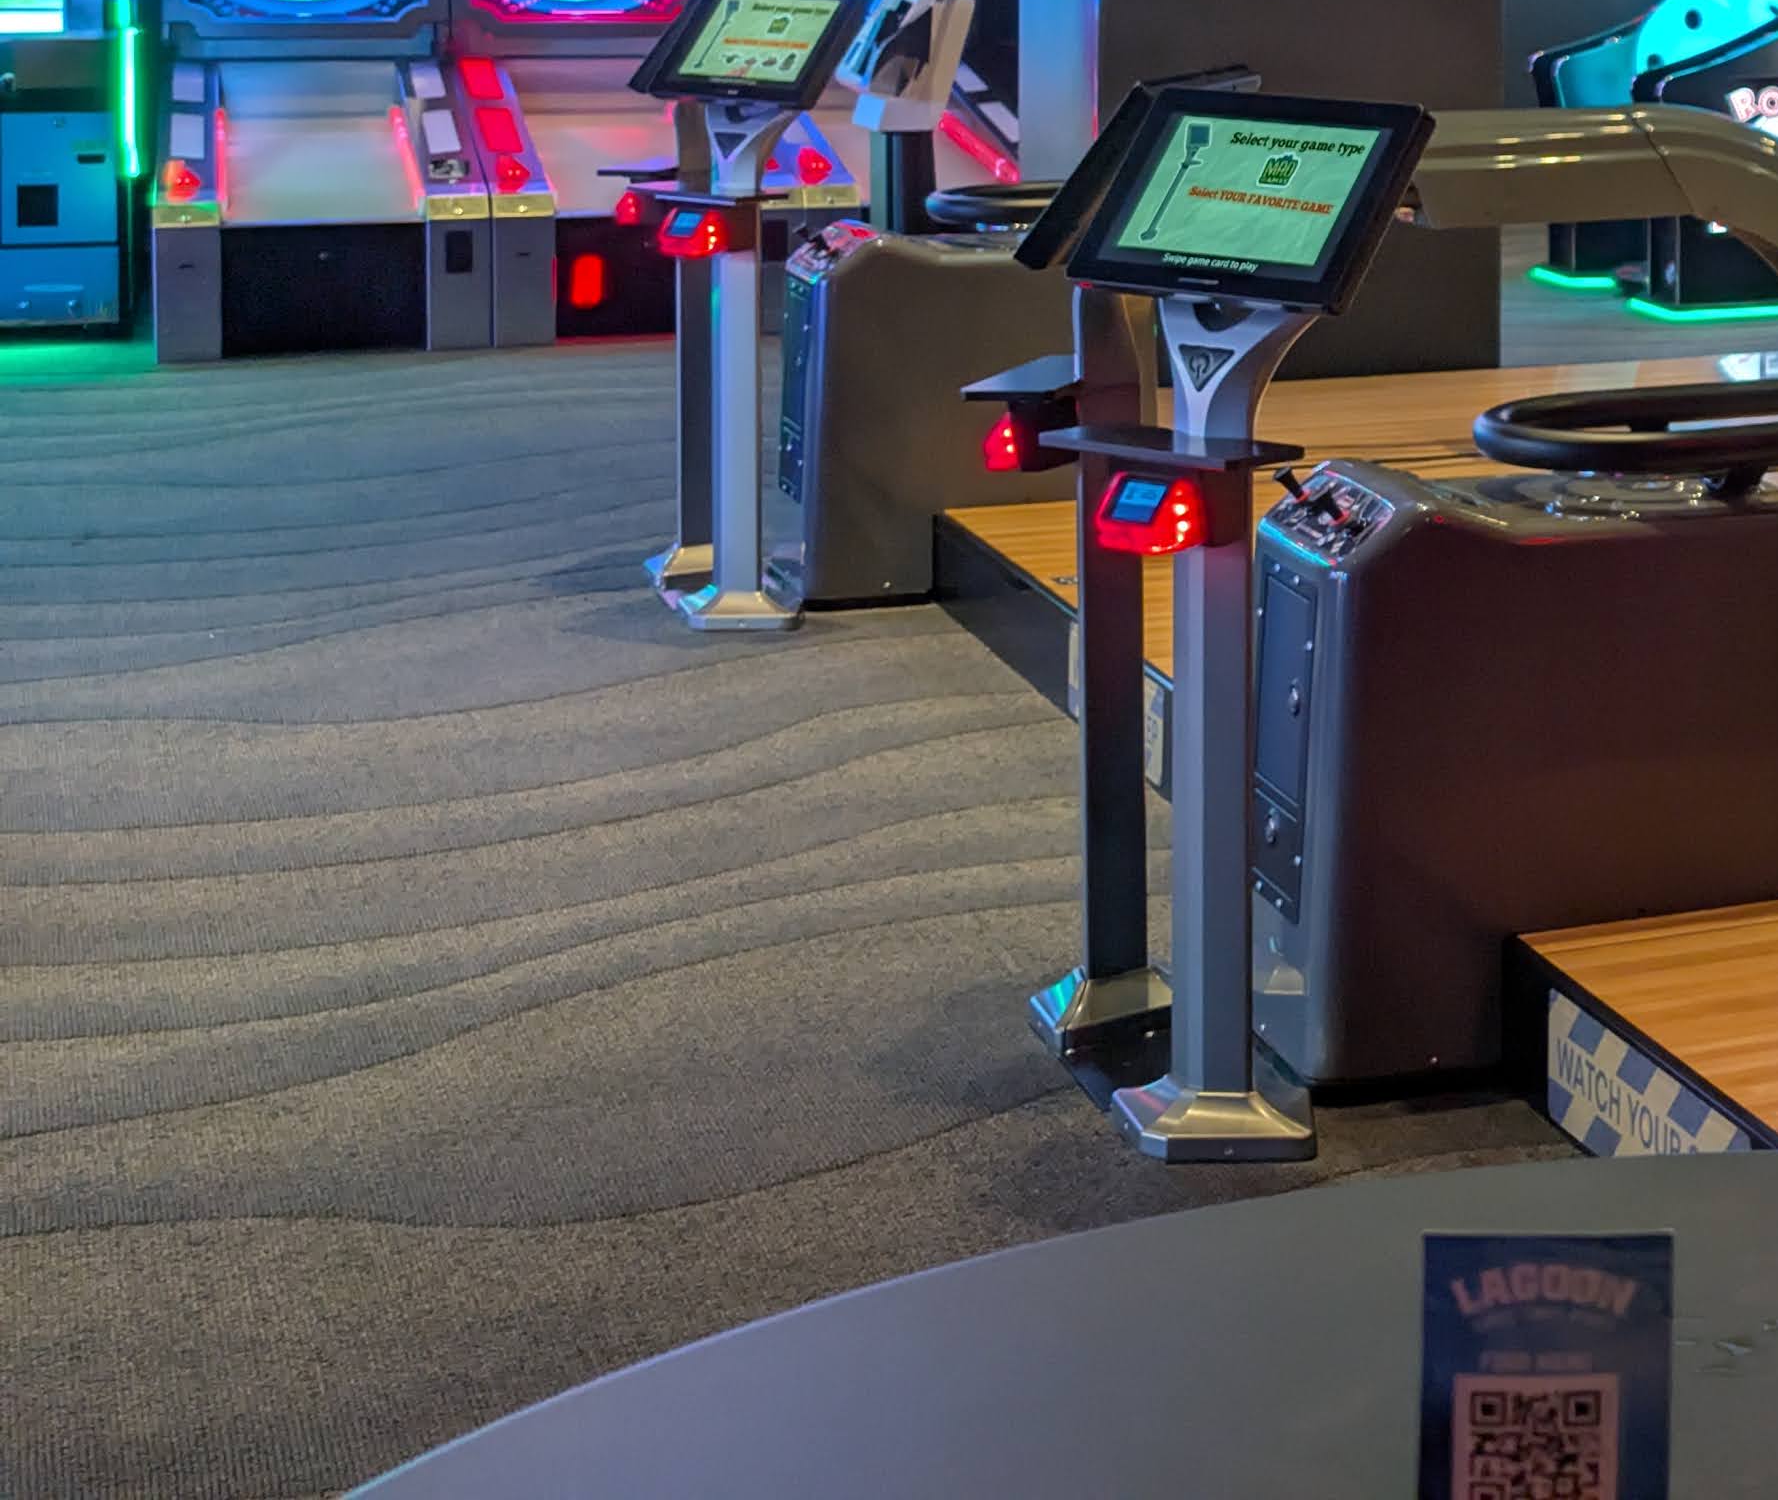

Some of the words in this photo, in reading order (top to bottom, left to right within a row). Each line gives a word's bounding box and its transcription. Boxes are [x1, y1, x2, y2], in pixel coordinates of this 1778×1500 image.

[1230, 131, 1268, 147] Select
[1270, 136, 1300, 150] your
[1300, 140, 1336, 153] game
[1337, 141, 1366, 157] type
[1188, 185, 1219, 199] Select
[1219, 189, 1246, 202] YOUR
[1247, 193, 1302, 211] FAVORITE
[1301, 202, 1336, 215] GAME
[1162, 252, 1187, 265] Swipe
[1186, 257, 1211, 267] game
[1210, 258, 1230, 268] card
[1229, 260, 1239, 269] to
[1238, 261, 1259, 273] play
[1556, 1038, 1621, 1126] WATCH
[1451, 1261, 1639, 1317] LAGOON
